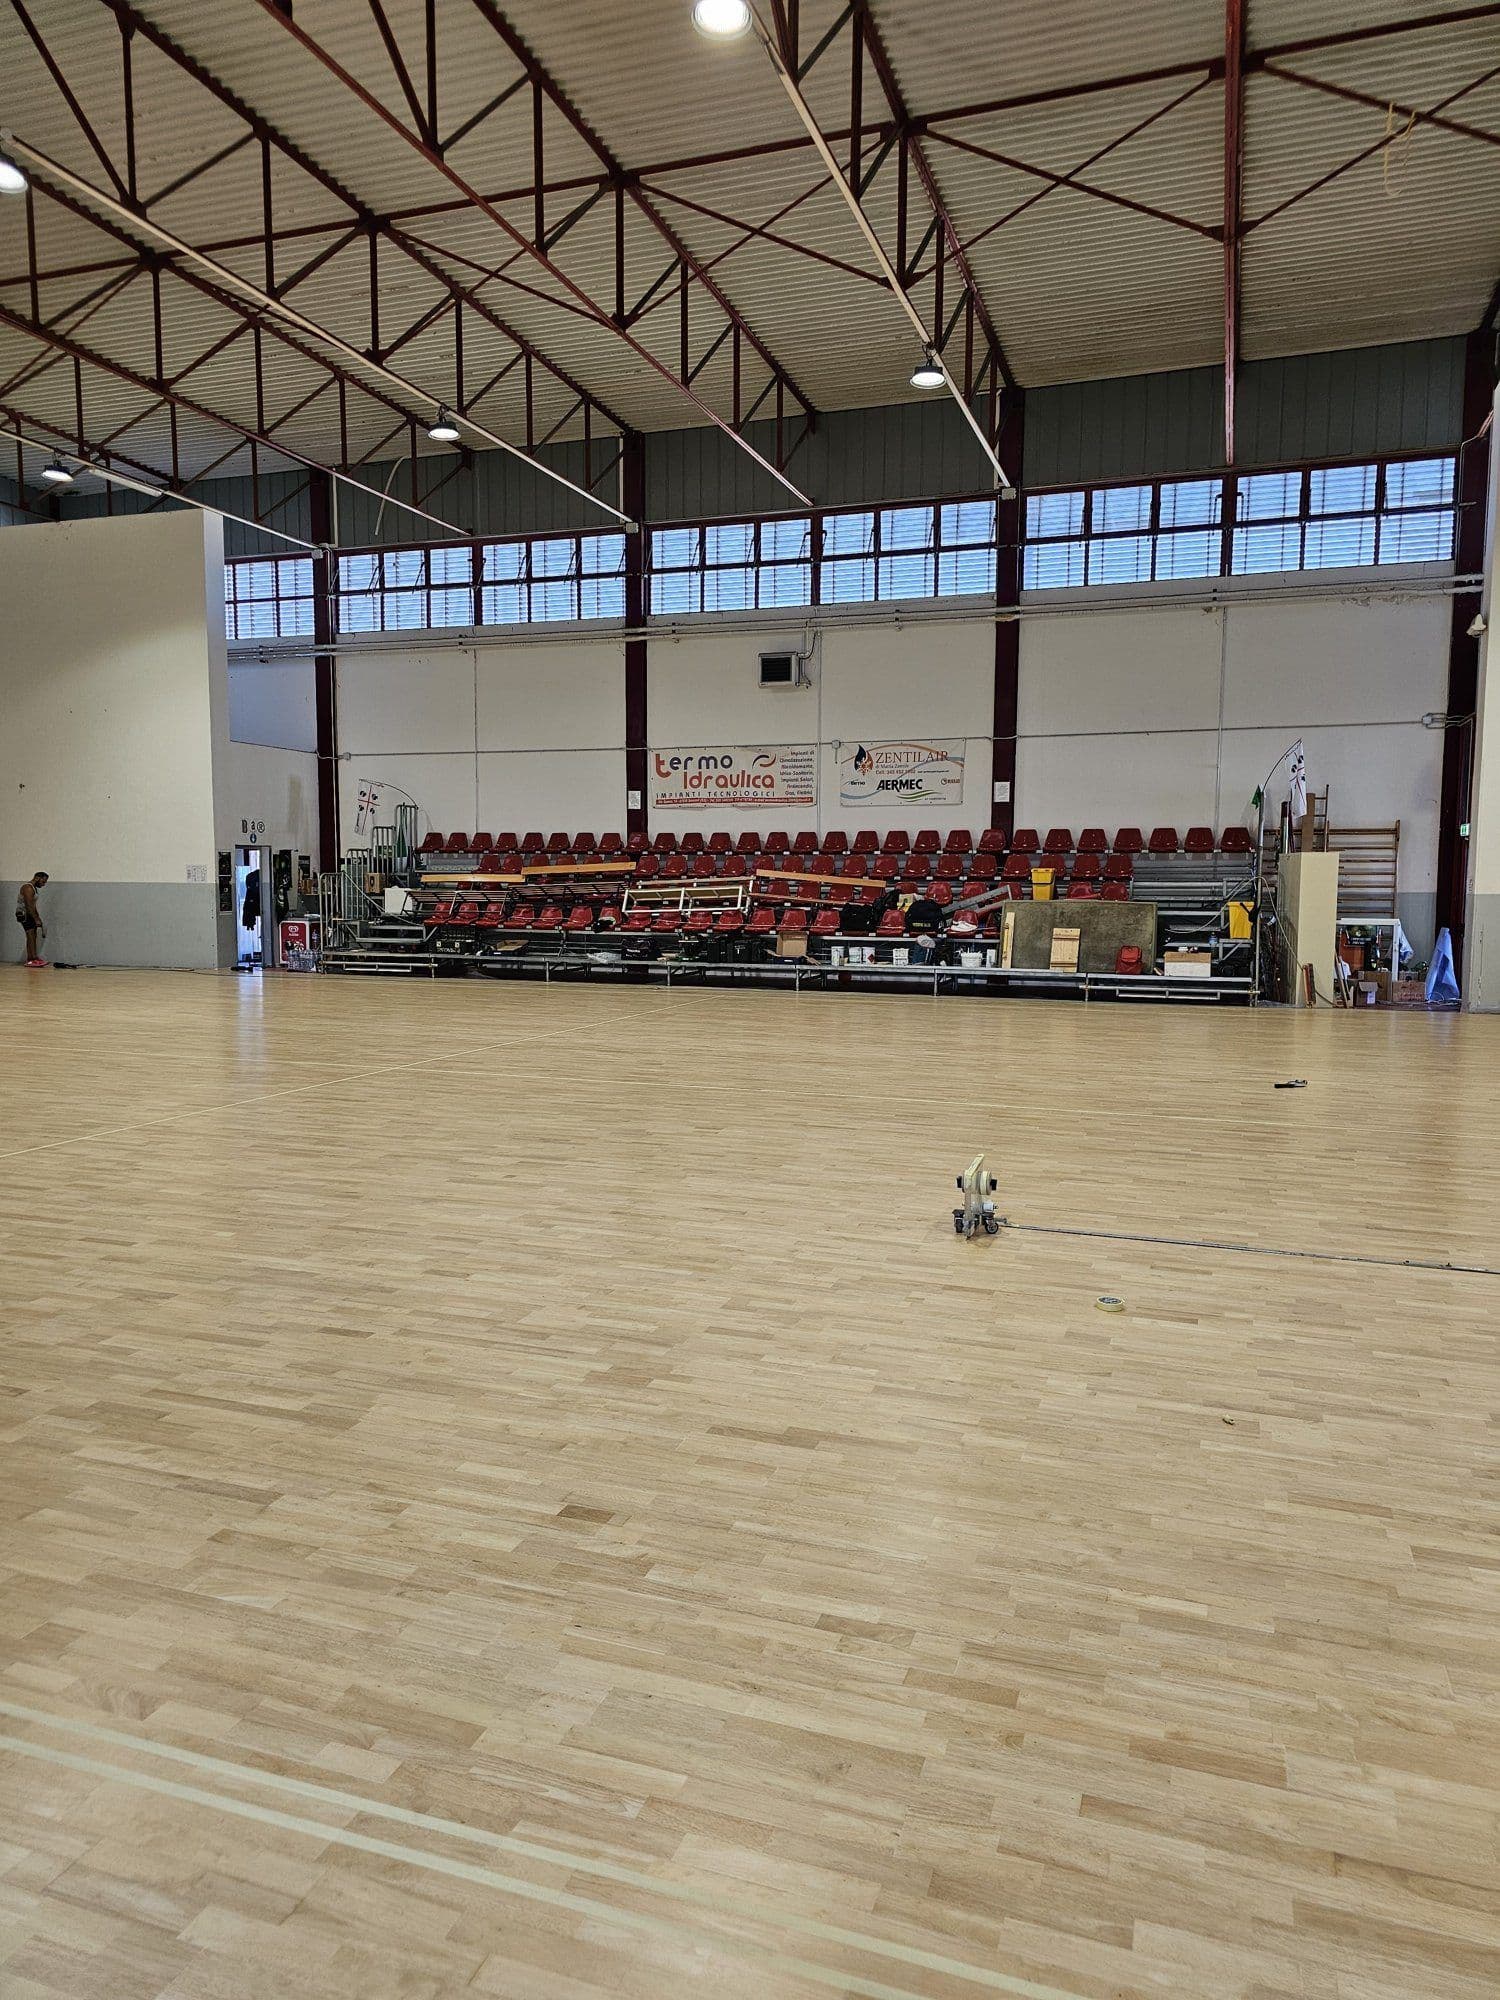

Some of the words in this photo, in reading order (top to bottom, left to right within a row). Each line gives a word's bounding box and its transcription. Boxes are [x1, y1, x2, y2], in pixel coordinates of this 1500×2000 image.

[875, 751, 950, 764] ZENTILAIR
[655, 754, 733, 778] termo
[876, 779, 923, 792] AERMEC
[656, 791, 701, 799] IMPIANTI
[707, 790, 775, 798] TECNOLOGICI
